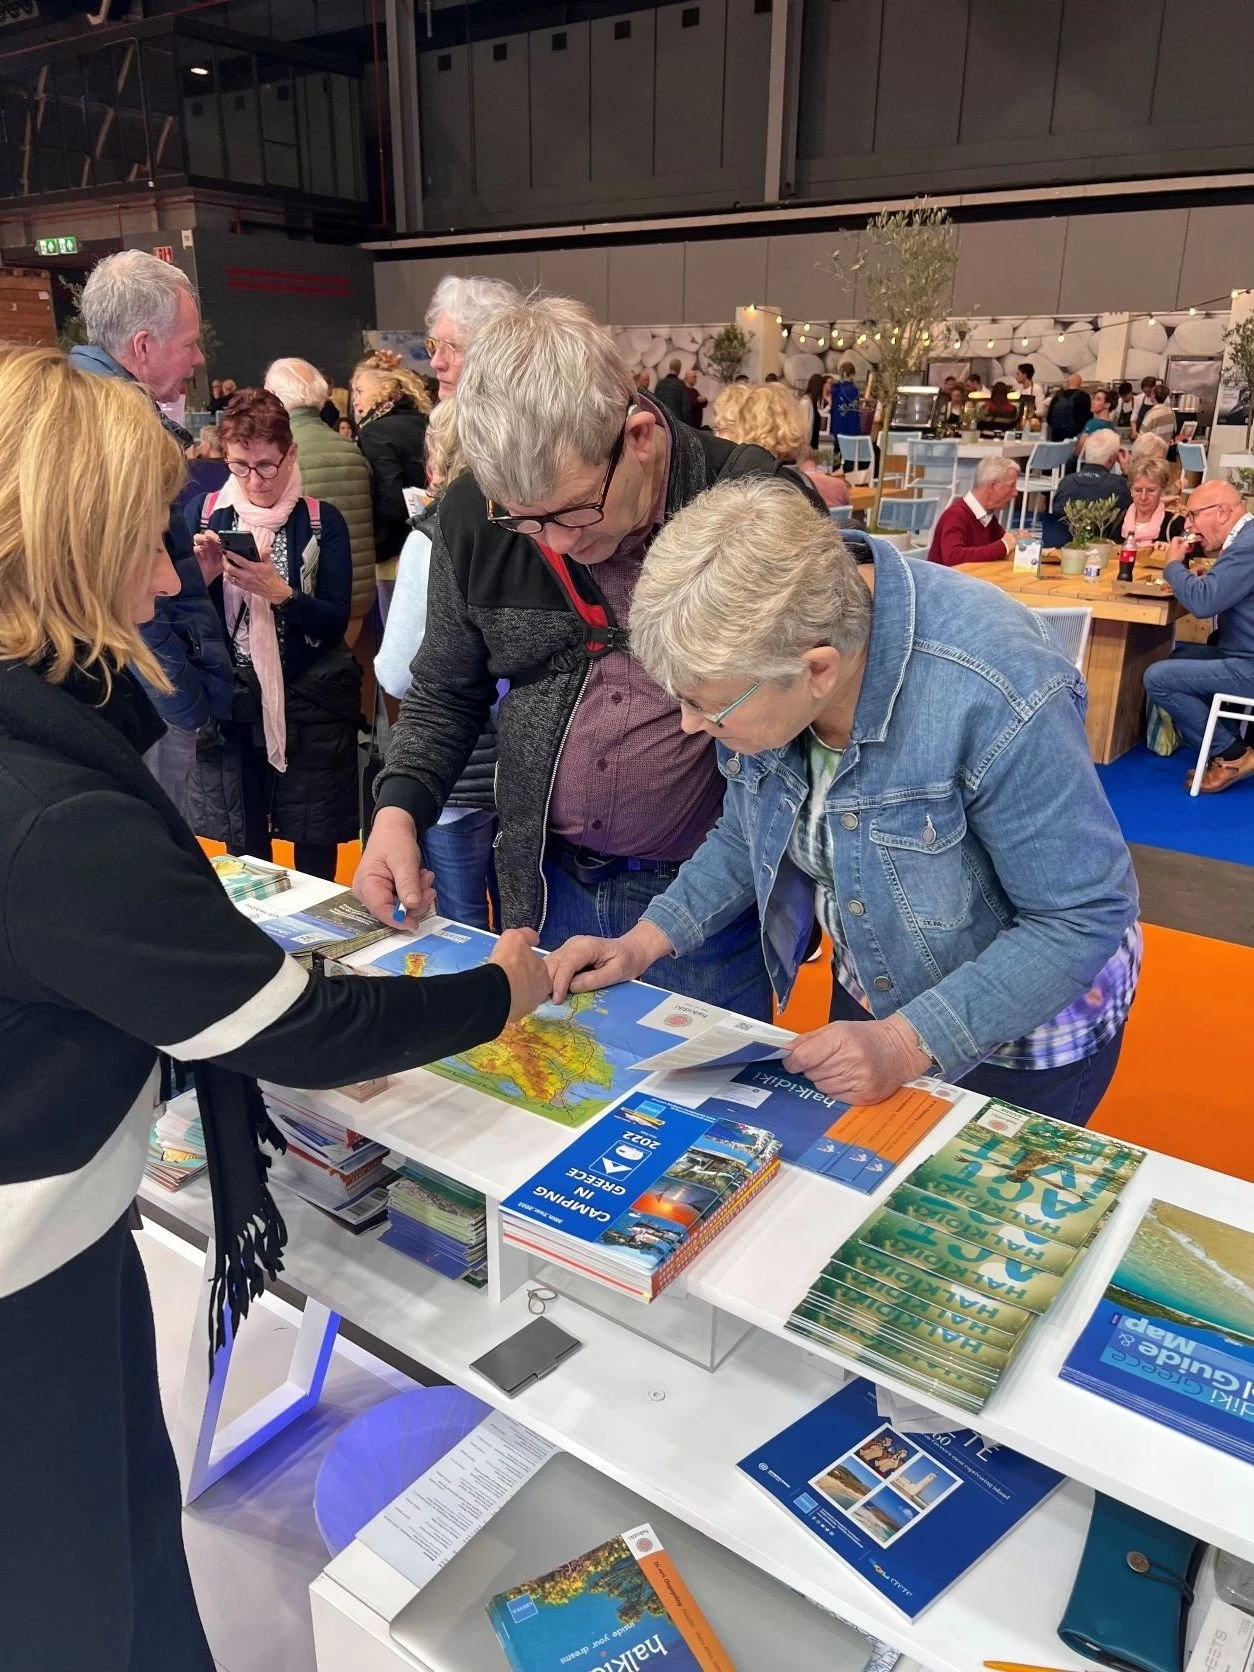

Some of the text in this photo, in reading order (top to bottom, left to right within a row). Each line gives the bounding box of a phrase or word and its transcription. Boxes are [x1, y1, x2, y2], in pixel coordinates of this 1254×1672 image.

[752, 1071, 837, 1109] halkidiki
[622, 1130, 662, 1150] 2022
[565, 1167, 627, 1197] GREECE
[573, 1187, 595, 1200] IN
[532, 1185, 611, 1222] CAMPING
[1118, 1331, 1136, 1347] &
[1124, 1317, 1197, 1356] Map
[1111, 1351, 1204, 1396] Greece
[1138, 1340, 1241, 1392] Guide
[993, 1485, 1011, 1501] island
[559, 1621, 636, 1665] inside your dreams
